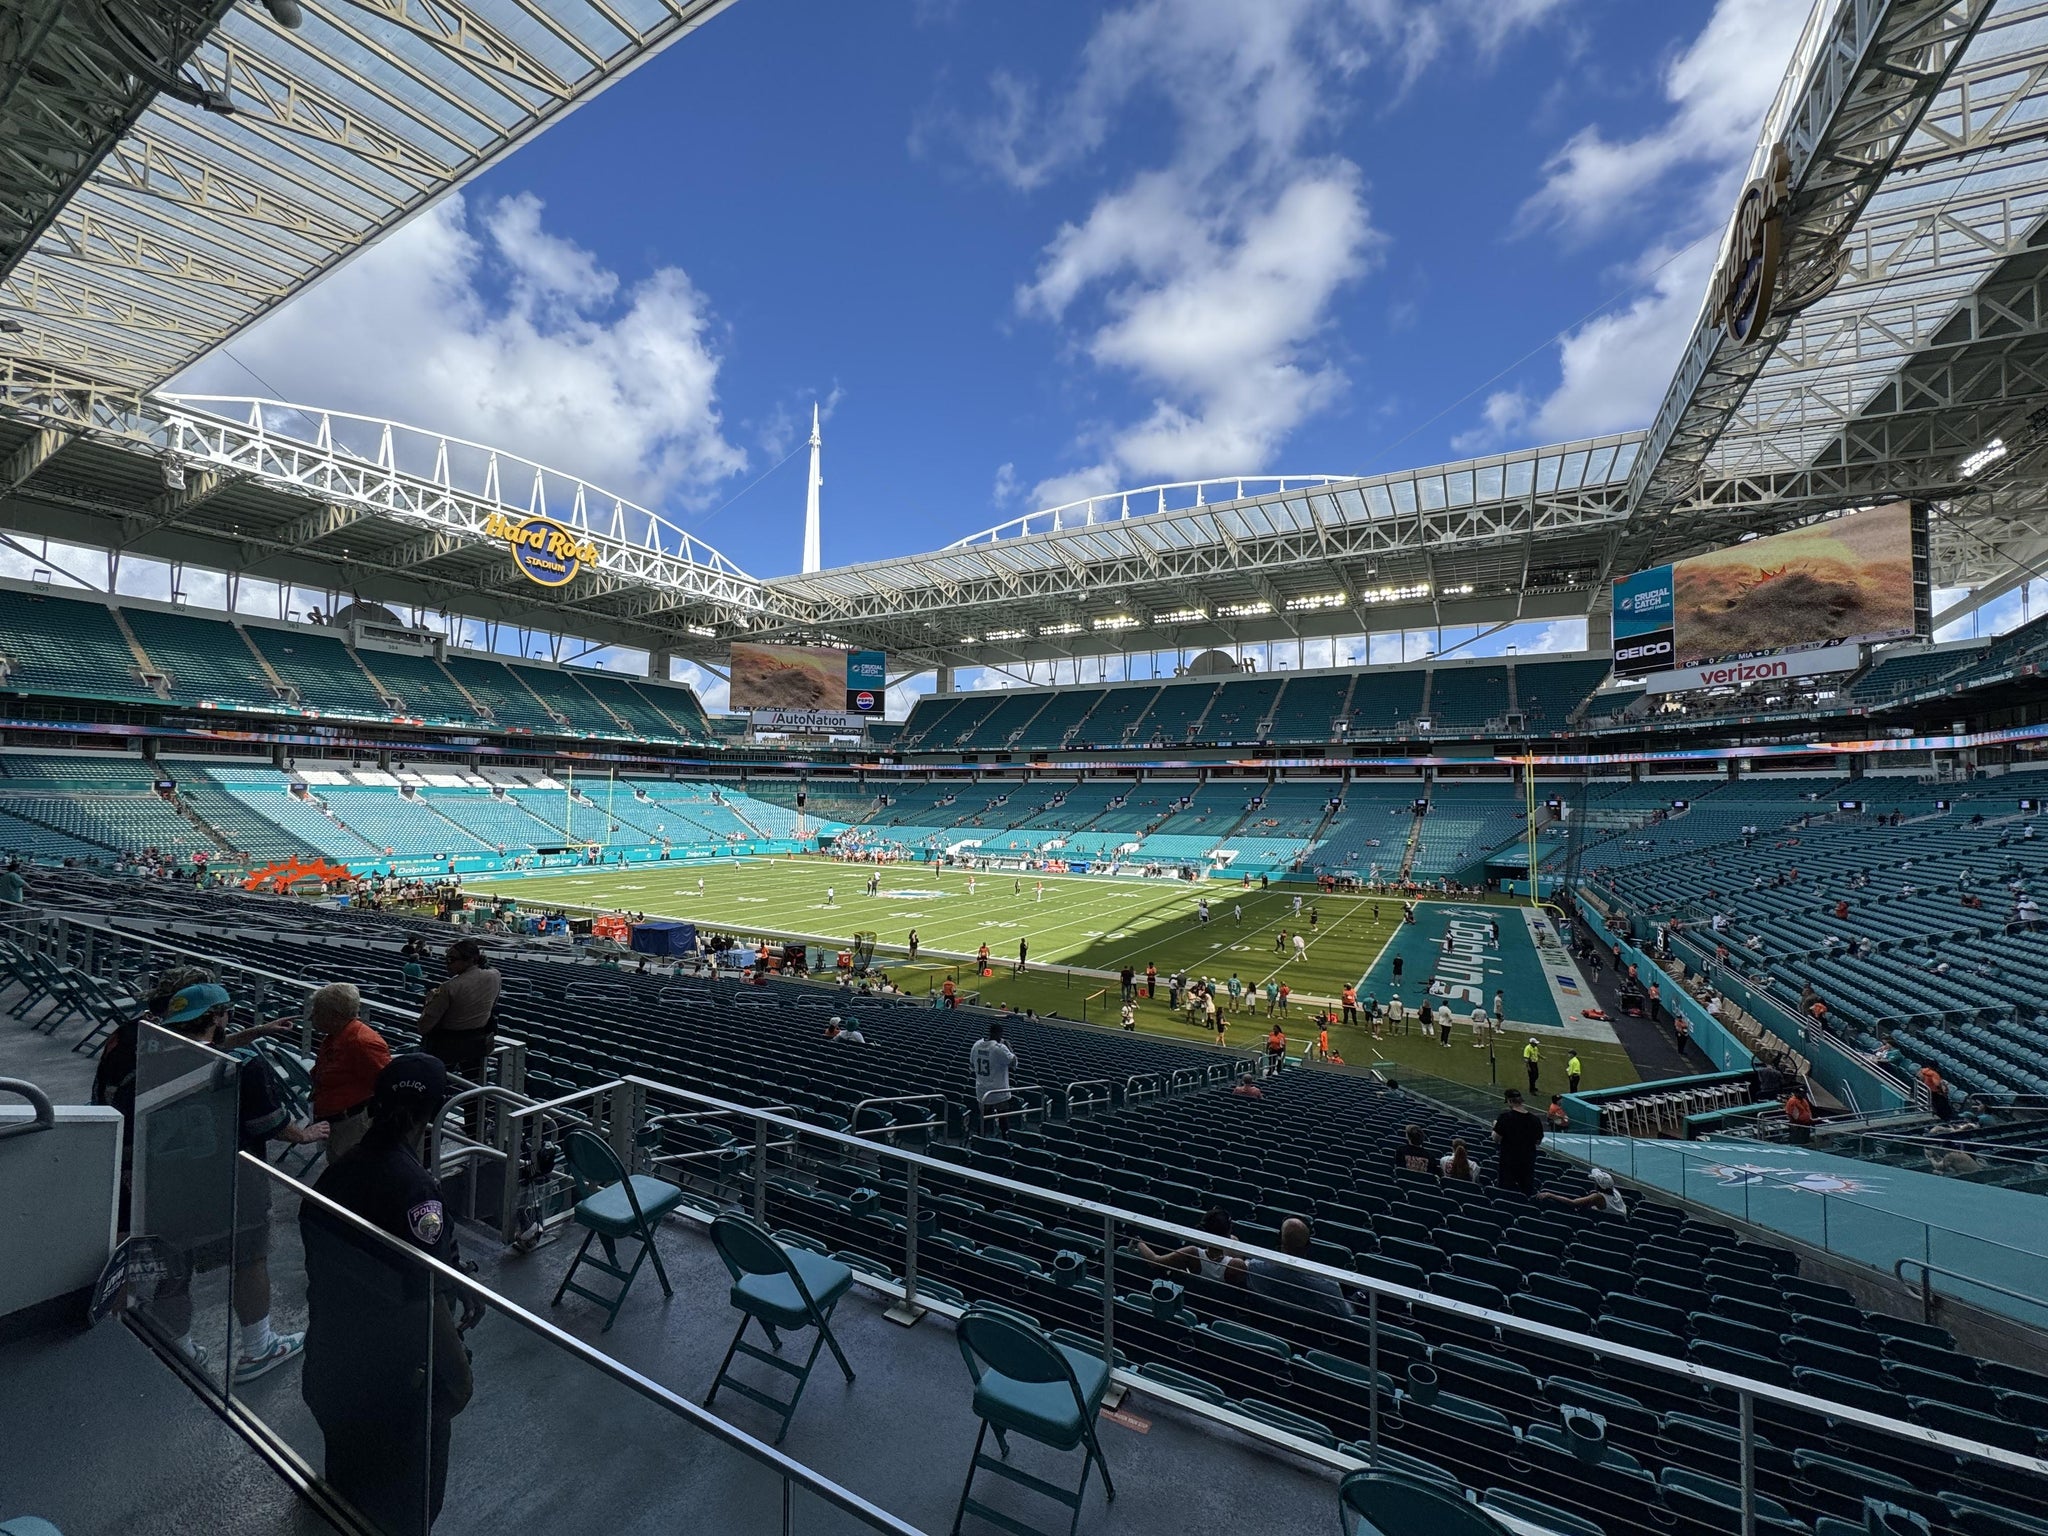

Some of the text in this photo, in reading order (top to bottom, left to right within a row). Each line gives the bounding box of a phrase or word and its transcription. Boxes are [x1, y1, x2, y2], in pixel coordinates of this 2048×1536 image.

[485, 512, 599, 569] Hard Rock
[525, 556, 566, 573] STADIUM
[1634, 588, 1670, 602] CRUCIAL
[1634, 597, 1661, 609] CATCH
[1615, 641, 1671, 661] GEICO
[1738, 652, 1754, 660] MIA
[1685, 660, 1699, 668] CIN
[1700, 661, 1788, 685] verizon
[776, 713, 847, 726] AutoNation
[397, 865, 441, 875] Dolphins
[977, 1057, 991, 1077] 13
[391, 1080, 428, 1093] POLICE
